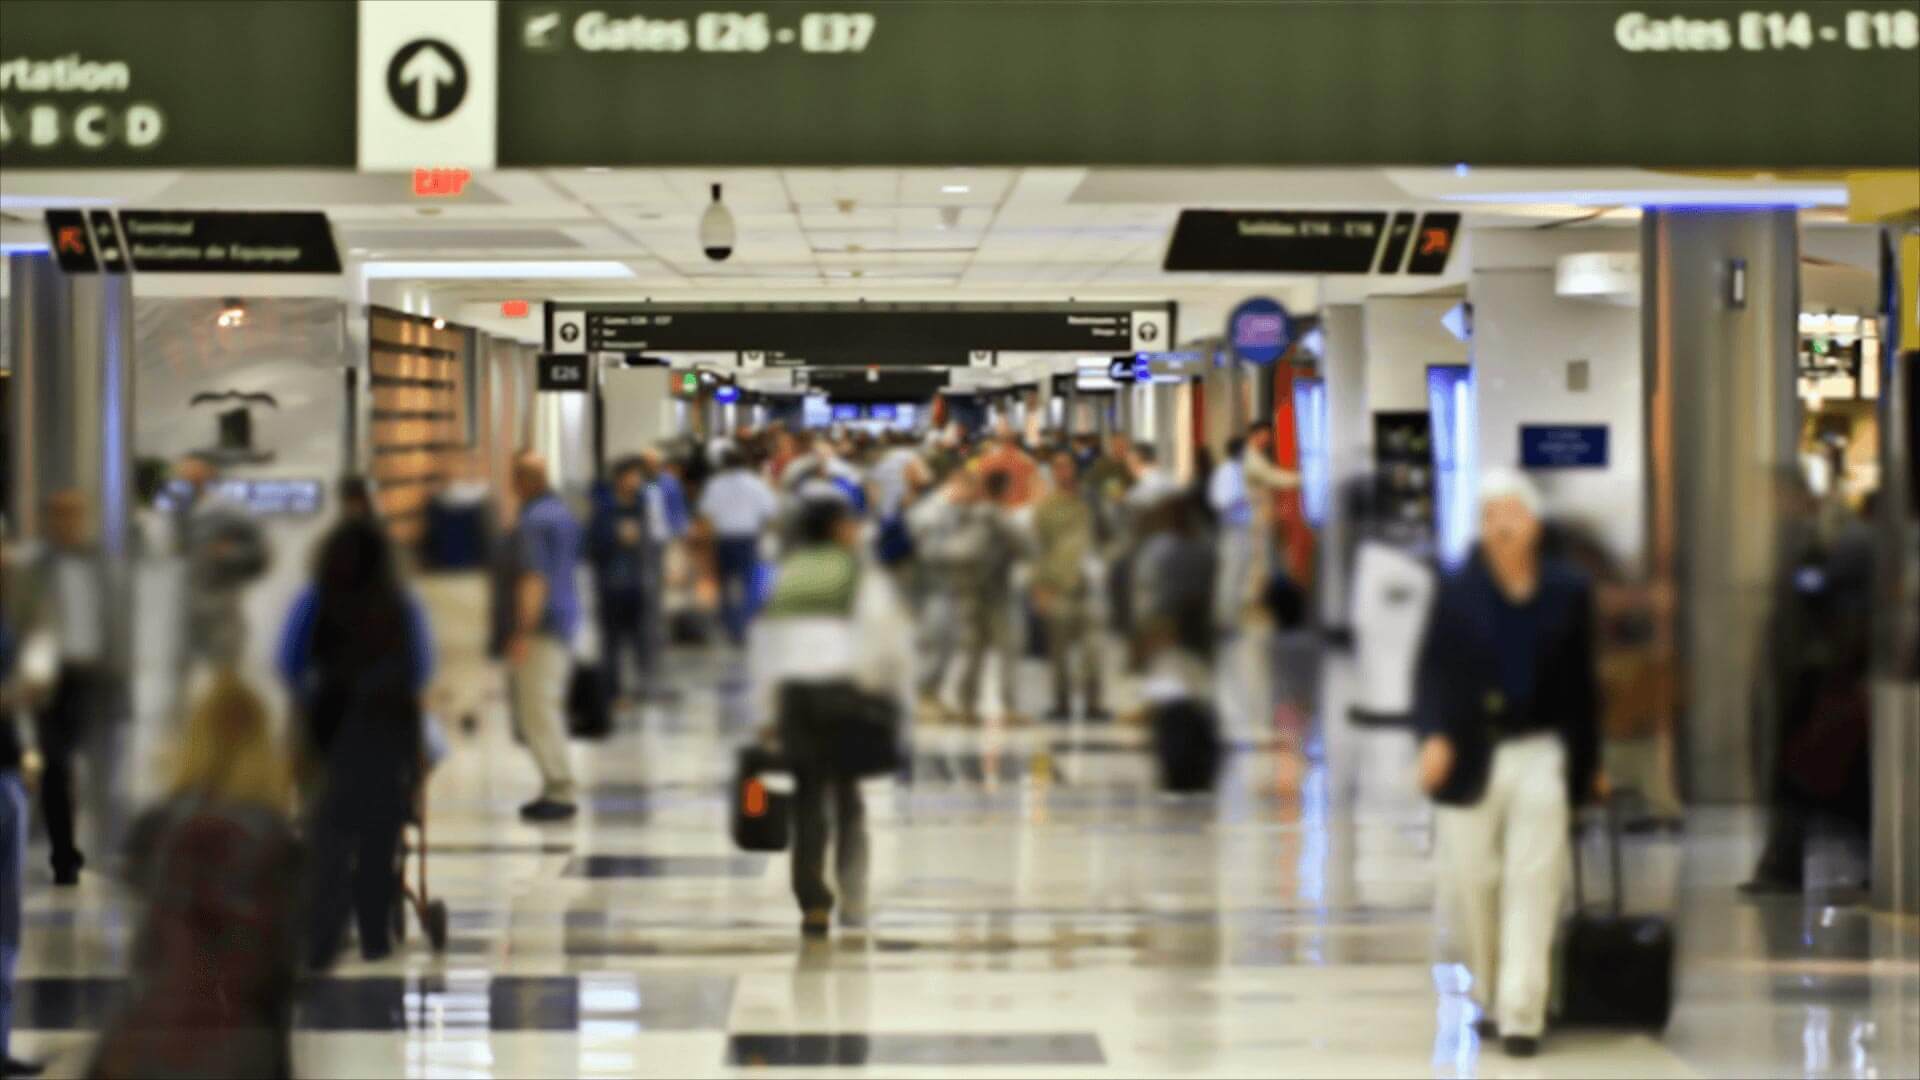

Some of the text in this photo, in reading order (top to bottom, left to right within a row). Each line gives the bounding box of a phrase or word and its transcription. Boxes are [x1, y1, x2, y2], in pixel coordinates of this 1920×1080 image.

[573, 10, 690, 51] Gates
[697, 11, 770, 52] E26
[801, 12, 875, 52] E37
[1615, 12, 1731, 51] Gates
[1739, 11, 1812, 50] E14
[75, 106, 106, 146] C
[126, 106, 162, 146] D
